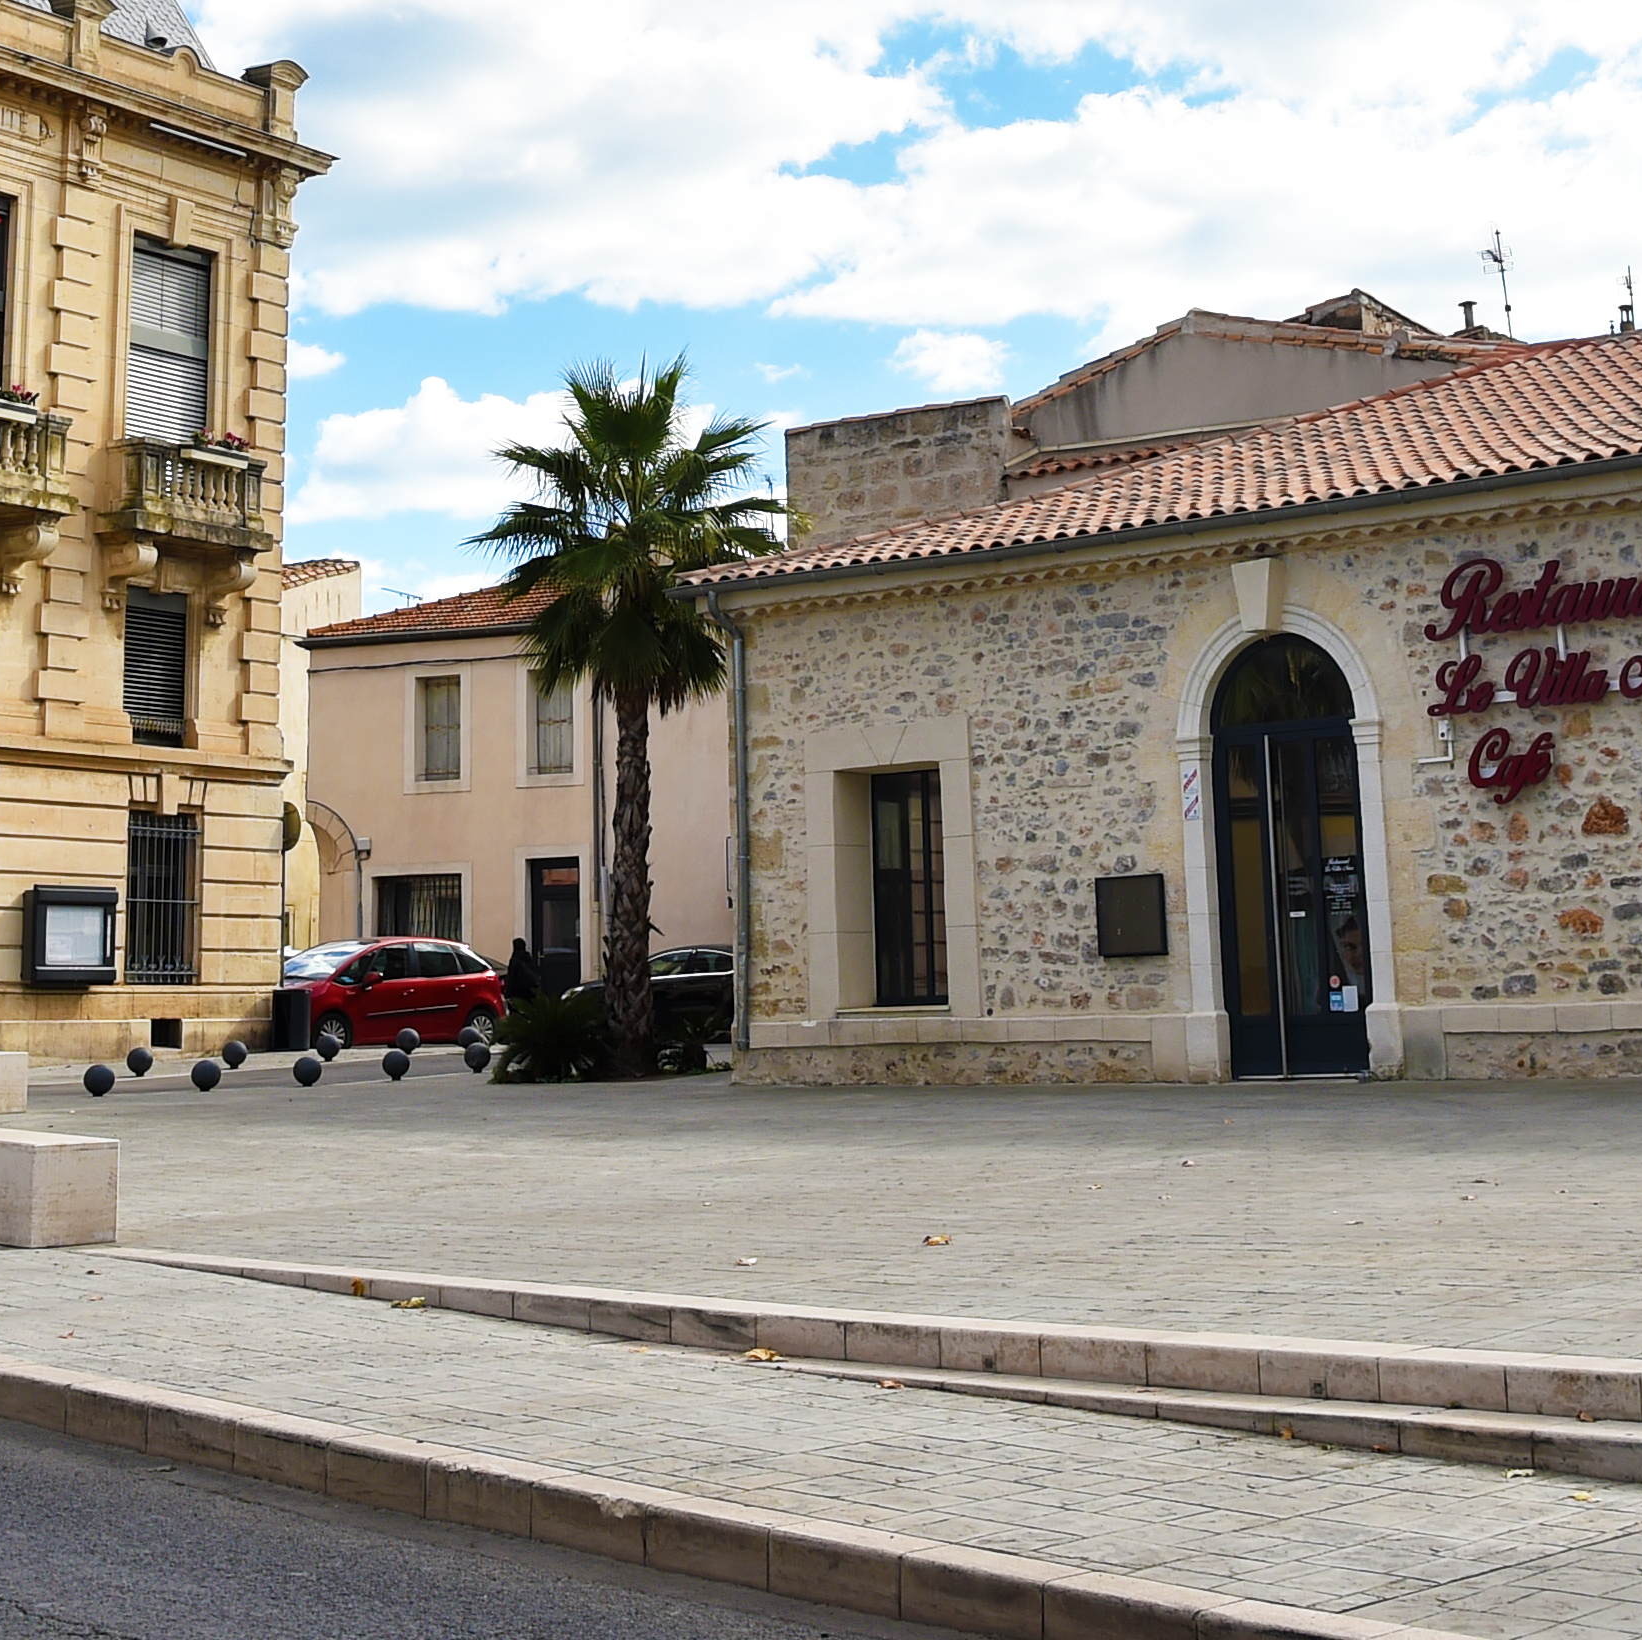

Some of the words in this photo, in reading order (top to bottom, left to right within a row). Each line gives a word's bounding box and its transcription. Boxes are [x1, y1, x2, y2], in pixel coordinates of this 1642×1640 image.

[1426, 654, 1496, 717] Le
[1504, 646, 1610, 709] Villa
[1467, 727, 1555, 805] Café
